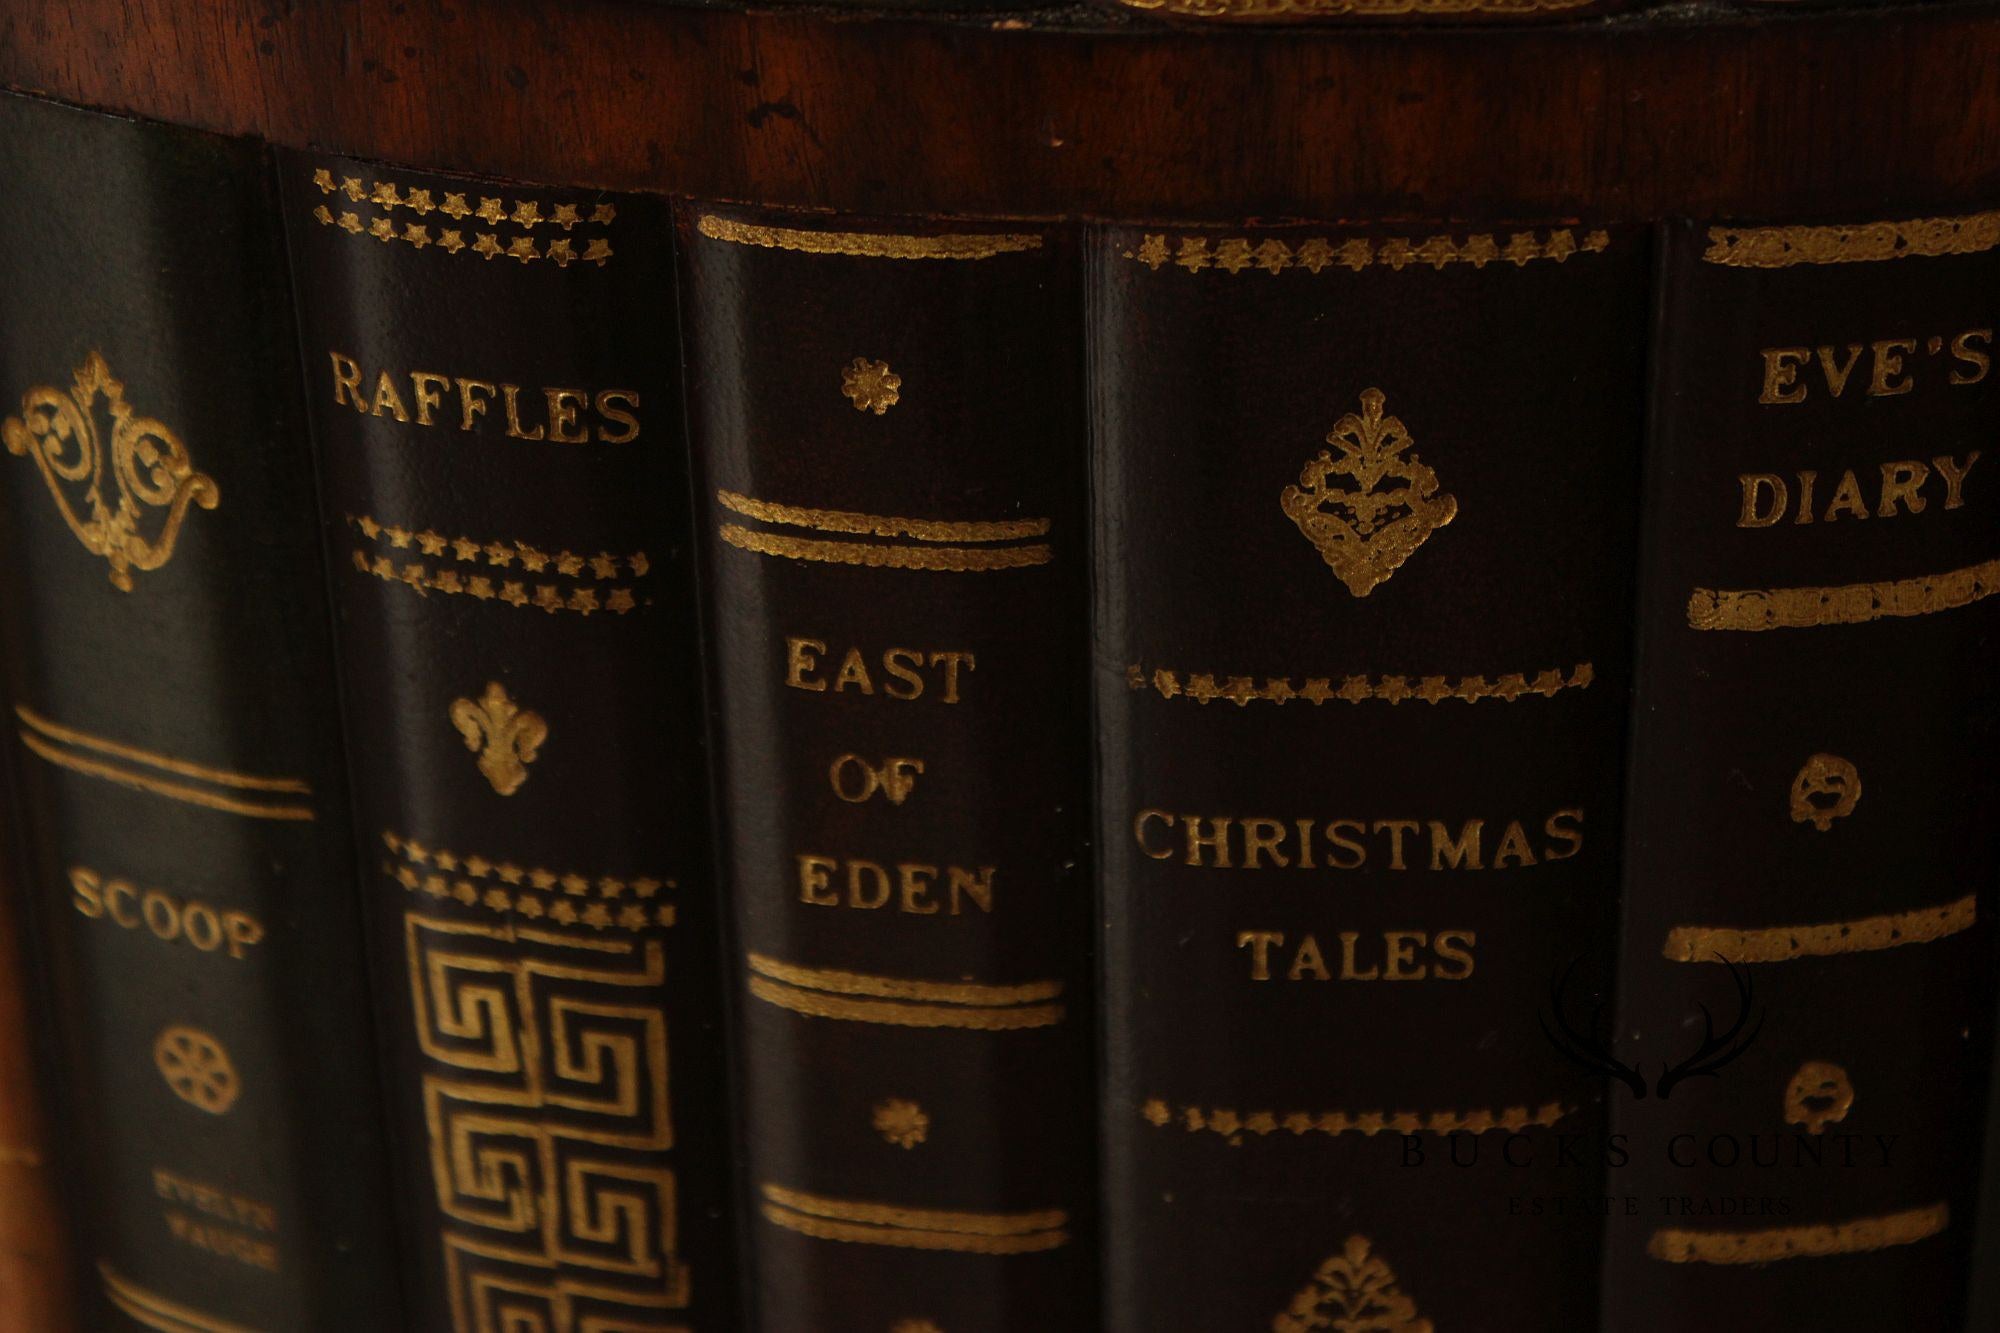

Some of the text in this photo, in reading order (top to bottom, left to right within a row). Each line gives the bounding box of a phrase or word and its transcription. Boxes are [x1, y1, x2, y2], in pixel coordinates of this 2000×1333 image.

[329, 351, 640, 444] RAFFLES
[1758, 328, 1993, 405] EVE'S
[1736, 450, 1982, 528] DIARY
[785, 635, 976, 704] EAST
[829, 754, 925, 806] OF
[1134, 808, 1585, 871] CHRISTMAS
[68, 865, 265, 959] SCOOP
[796, 854, 996, 916] EDEN
[1236, 929, 1477, 981] TALES
